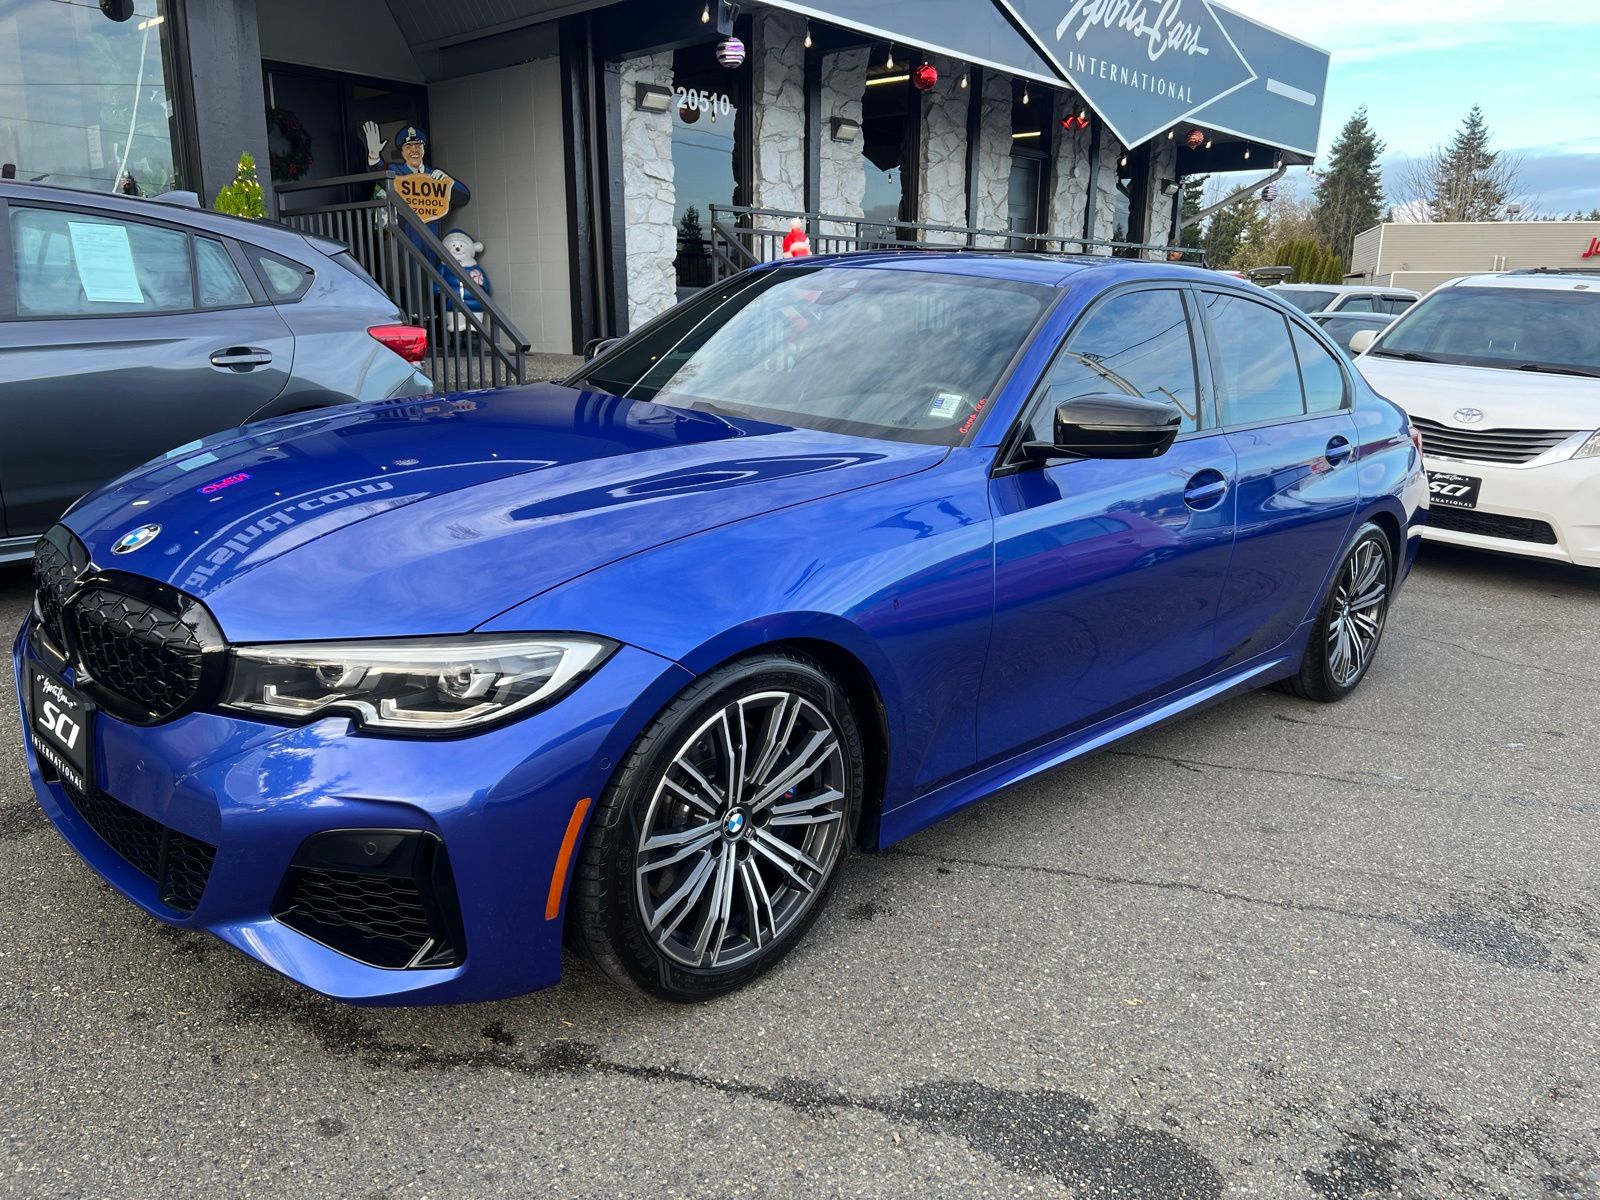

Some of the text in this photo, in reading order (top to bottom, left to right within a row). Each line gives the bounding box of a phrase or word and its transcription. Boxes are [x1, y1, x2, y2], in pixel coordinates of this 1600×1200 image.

[1148, 0, 1209, 61] Cars
[1068, 51, 1193, 104] INTERNATIONAL
[676, 86, 730, 116] 20510
[401, 180, 447, 198] SLOW
[405, 197, 444, 207] SCHOOL
[412, 207, 438, 216] ZONE
[1429, 481, 1471, 497] SCI
[39, 701, 80, 749] SCI
[31, 733, 83, 791] INTERNATIONAL
